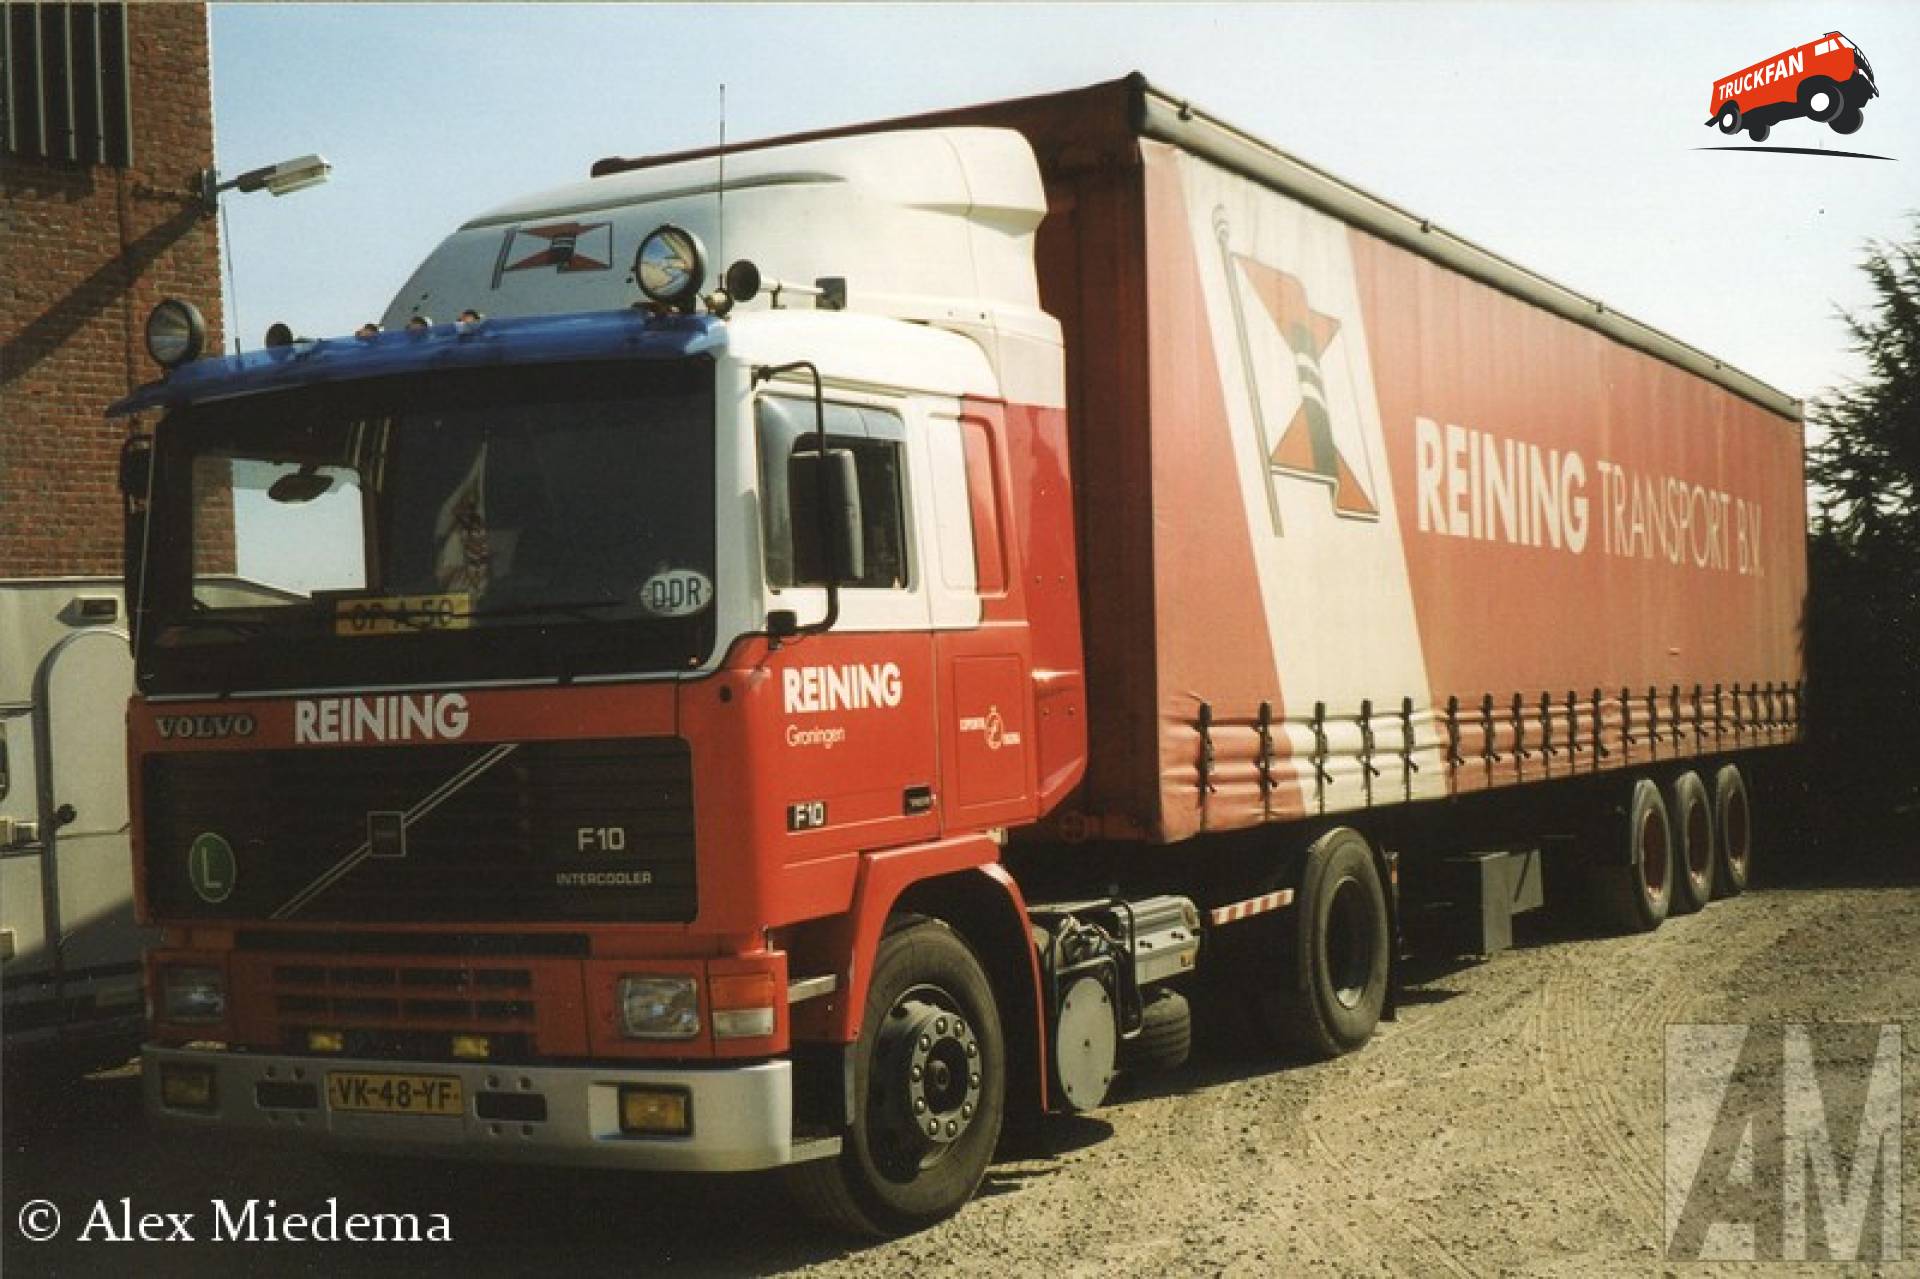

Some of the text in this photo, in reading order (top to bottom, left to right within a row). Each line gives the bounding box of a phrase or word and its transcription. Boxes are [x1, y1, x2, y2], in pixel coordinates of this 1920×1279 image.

[1415, 415, 1590, 554] REINING
[1597, 460, 1731, 571] TRANSPORT
[653, 576, 702, 608] DDR
[783, 662, 902, 713] REINING
[155, 715, 254, 738] VOLVO
[295, 692, 469, 745] REINING
[794, 802, 824, 828] F10
[577, 827, 625, 852] F10
[556, 871, 652, 885] INTERCOOLER
[335, 1076, 452, 1110] VK-48-YF
